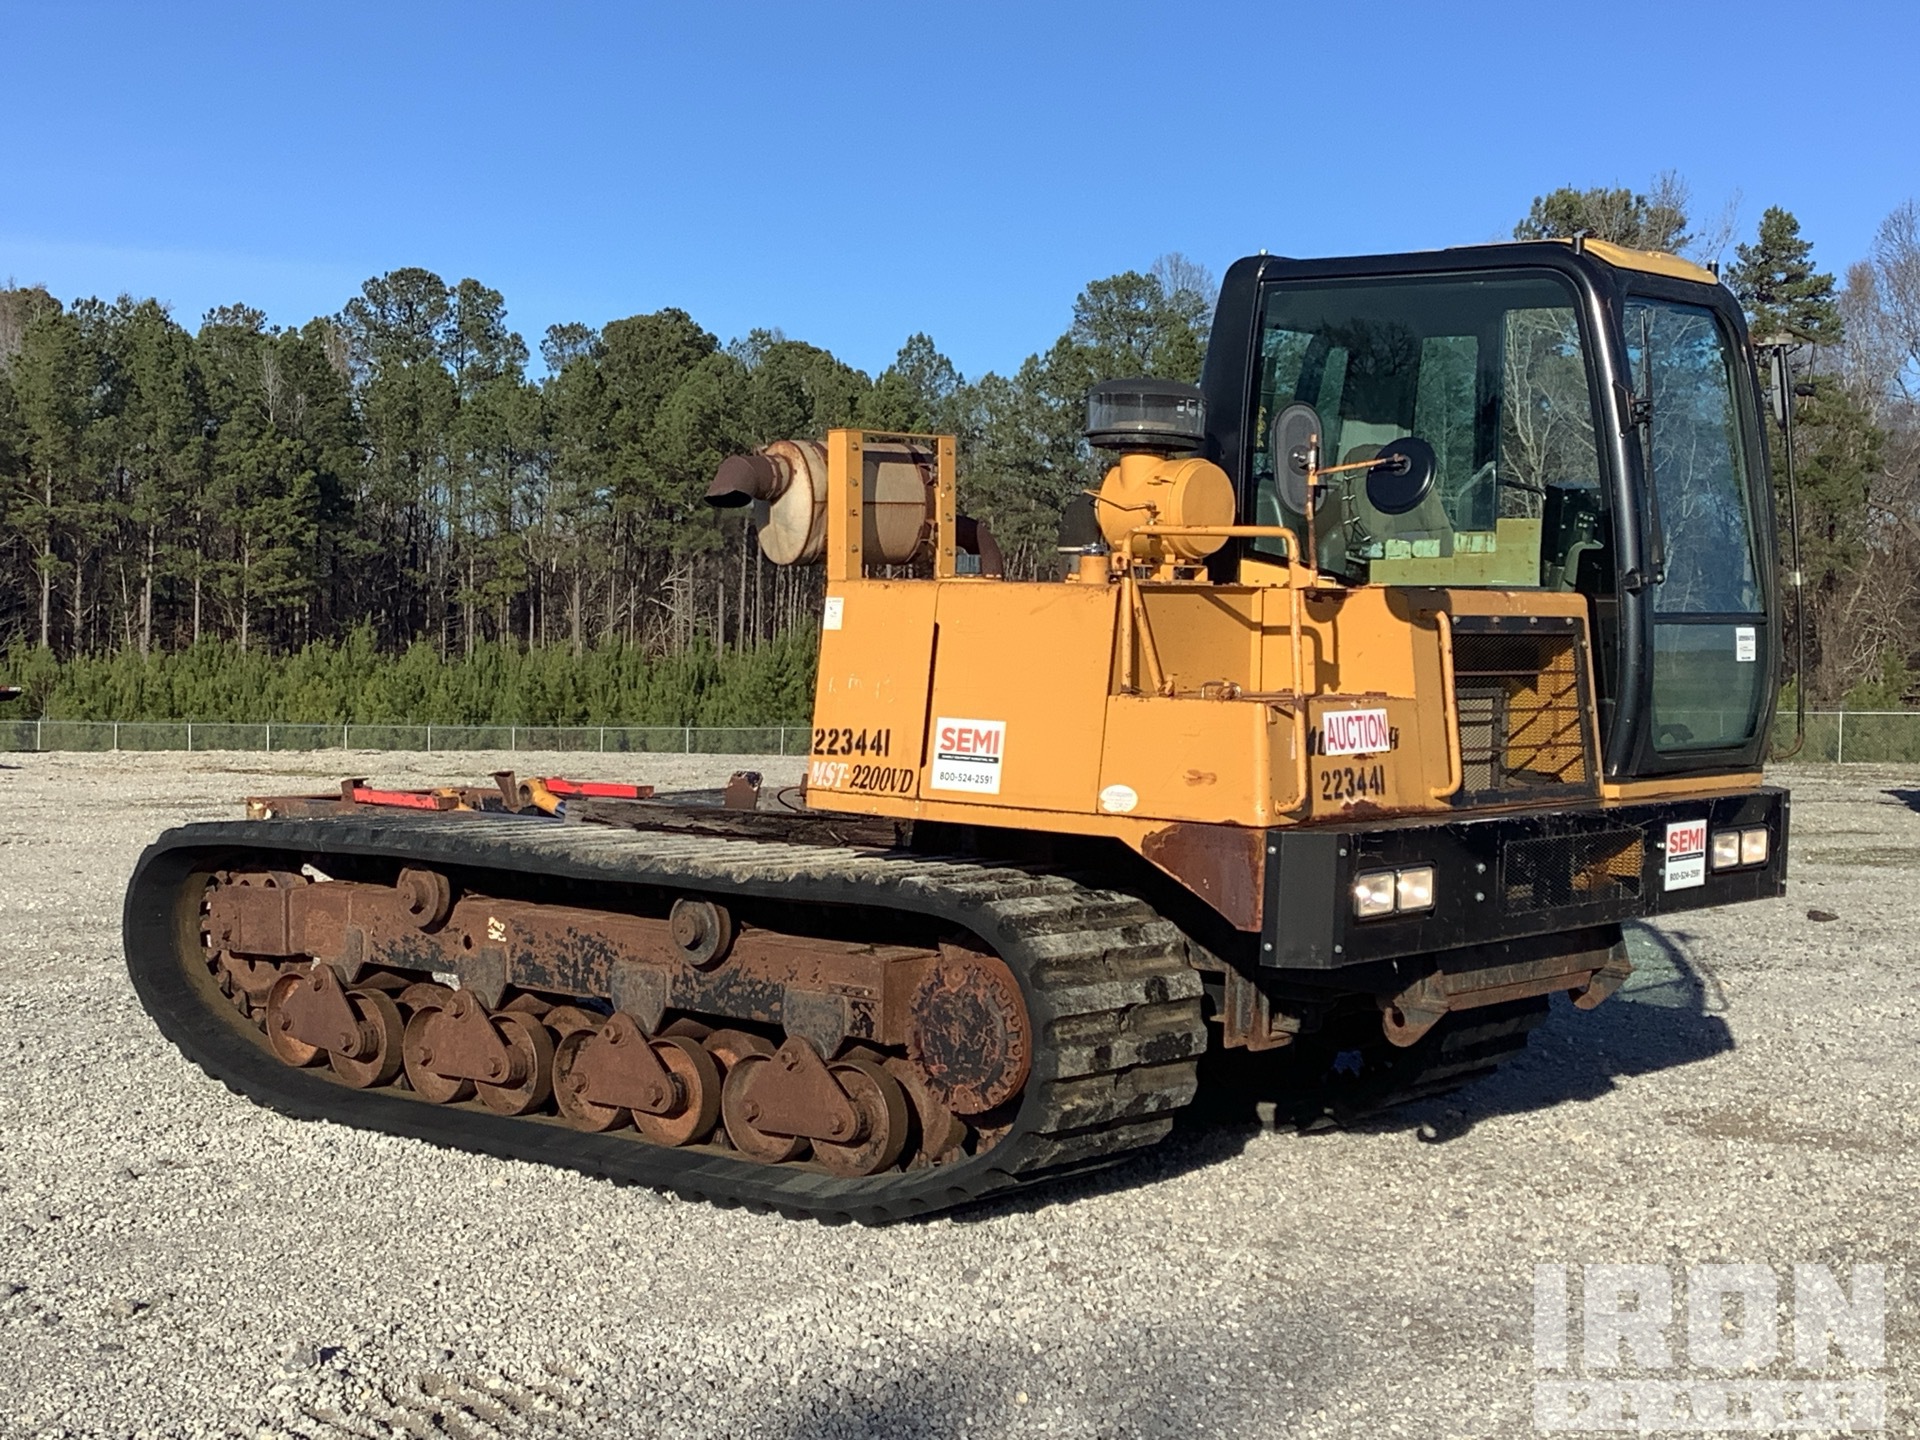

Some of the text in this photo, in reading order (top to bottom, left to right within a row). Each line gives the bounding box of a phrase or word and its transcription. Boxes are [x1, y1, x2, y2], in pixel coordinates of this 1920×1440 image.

[813, 728, 891, 757] 223441
[940, 727, 1000, 755] SEMI
[1328, 714, 1388, 751] AUCTION
[939, 771, 993, 785] 800-524-2591
[1321, 764, 1386, 801] 223441
[1669, 828, 1704, 854] SEMI
